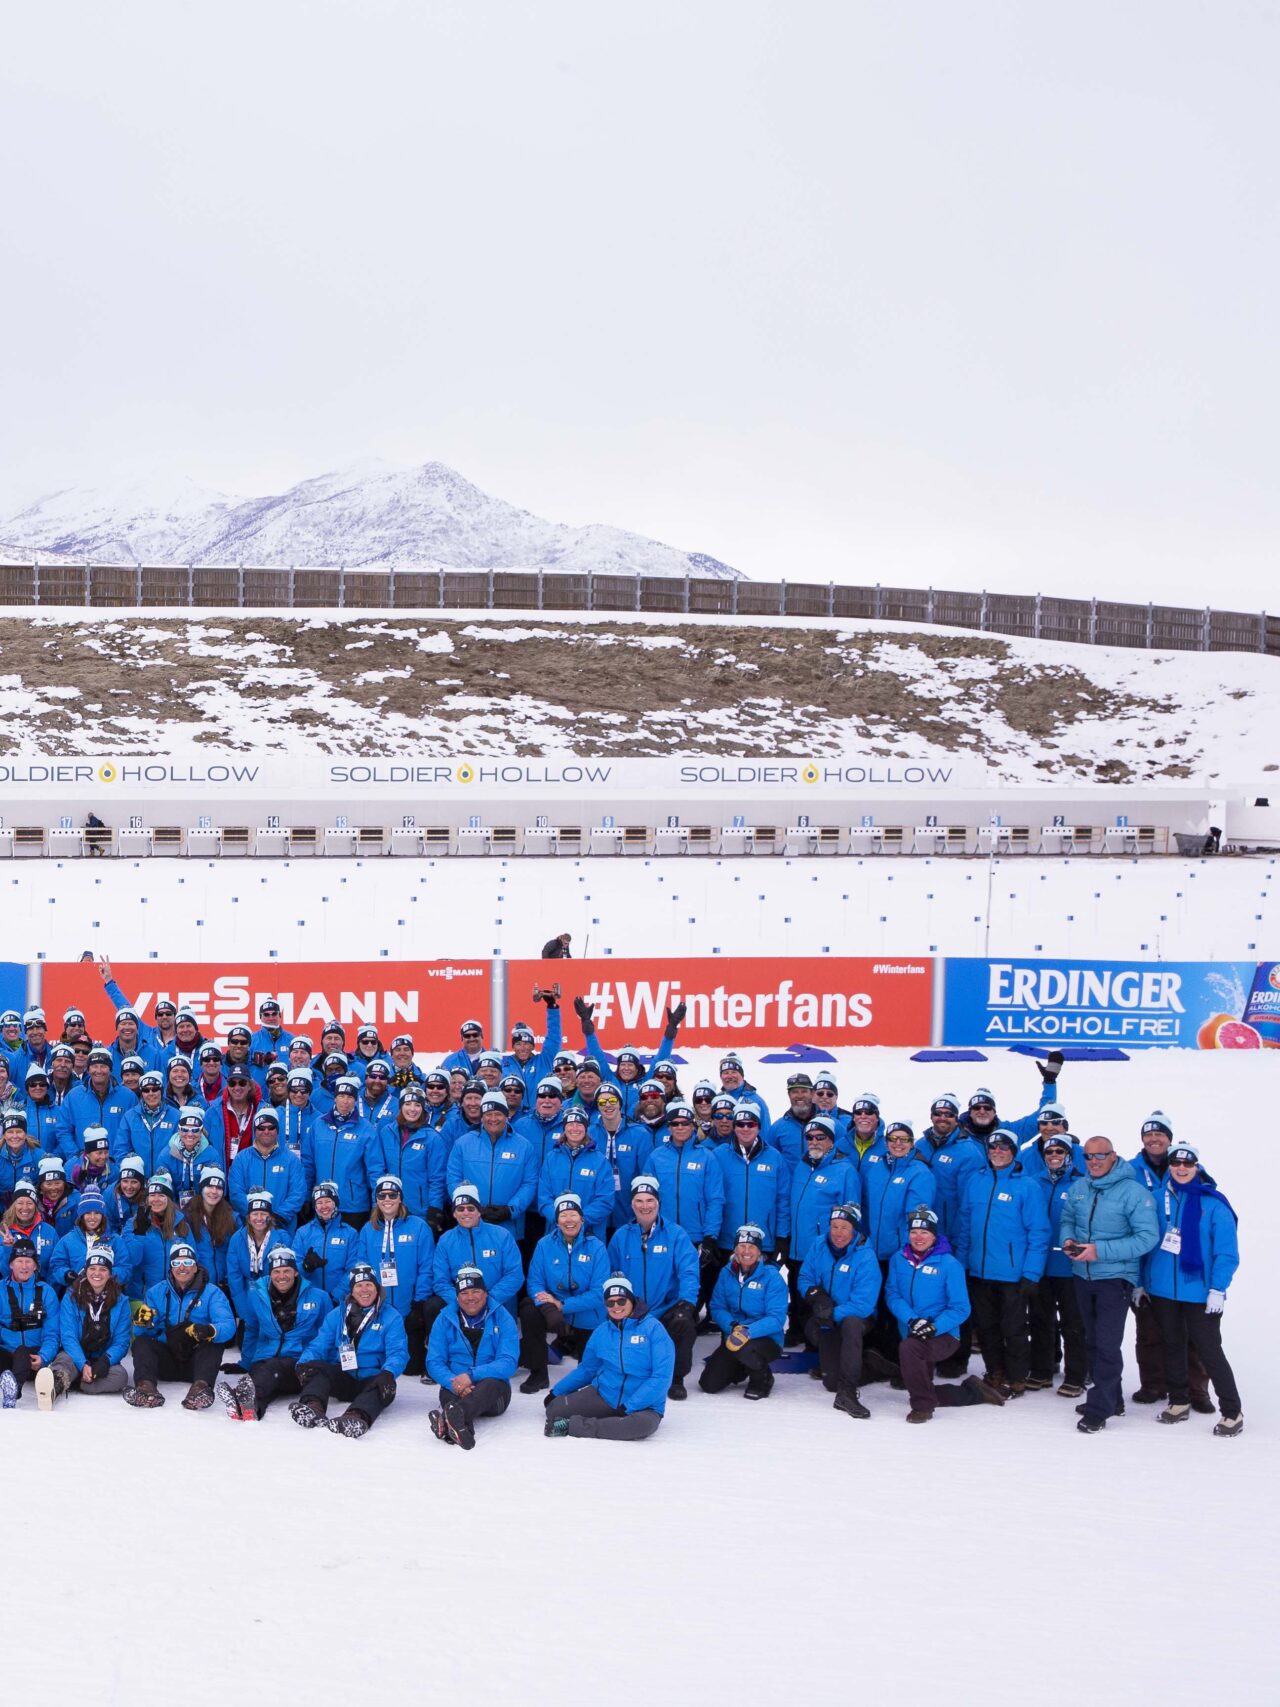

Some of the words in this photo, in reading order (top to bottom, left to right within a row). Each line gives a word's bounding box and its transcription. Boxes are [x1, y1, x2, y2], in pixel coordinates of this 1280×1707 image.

[122, 766, 260, 782] HOLLOW
[330, 766, 452, 783] SOLDIER
[479, 766, 612, 783] HOLLOW
[680, 767, 798, 783] SOLDIER
[824, 767, 953, 783] HOLLOW
[61, 817, 72, 828] 17
[131, 817, 142, 828] 16
[200, 817, 211, 827] 15
[268, 817, 279, 827] 14
[337, 817, 347, 827] 13
[403, 817, 414, 827] 12
[470, 817, 480, 827] 11
[537, 817, 548, 827] 10
[428, 966, 483, 980] VIESSMANN
[872, 964, 925, 974] #Winterfans
[987, 964, 1186, 1013] ERDINGER
[1251, 991, 1280, 1003] ERDI
[583, 980, 873, 1030] #Winterfans
[985, 1015, 1181, 1036] ALKOHOLFREI
